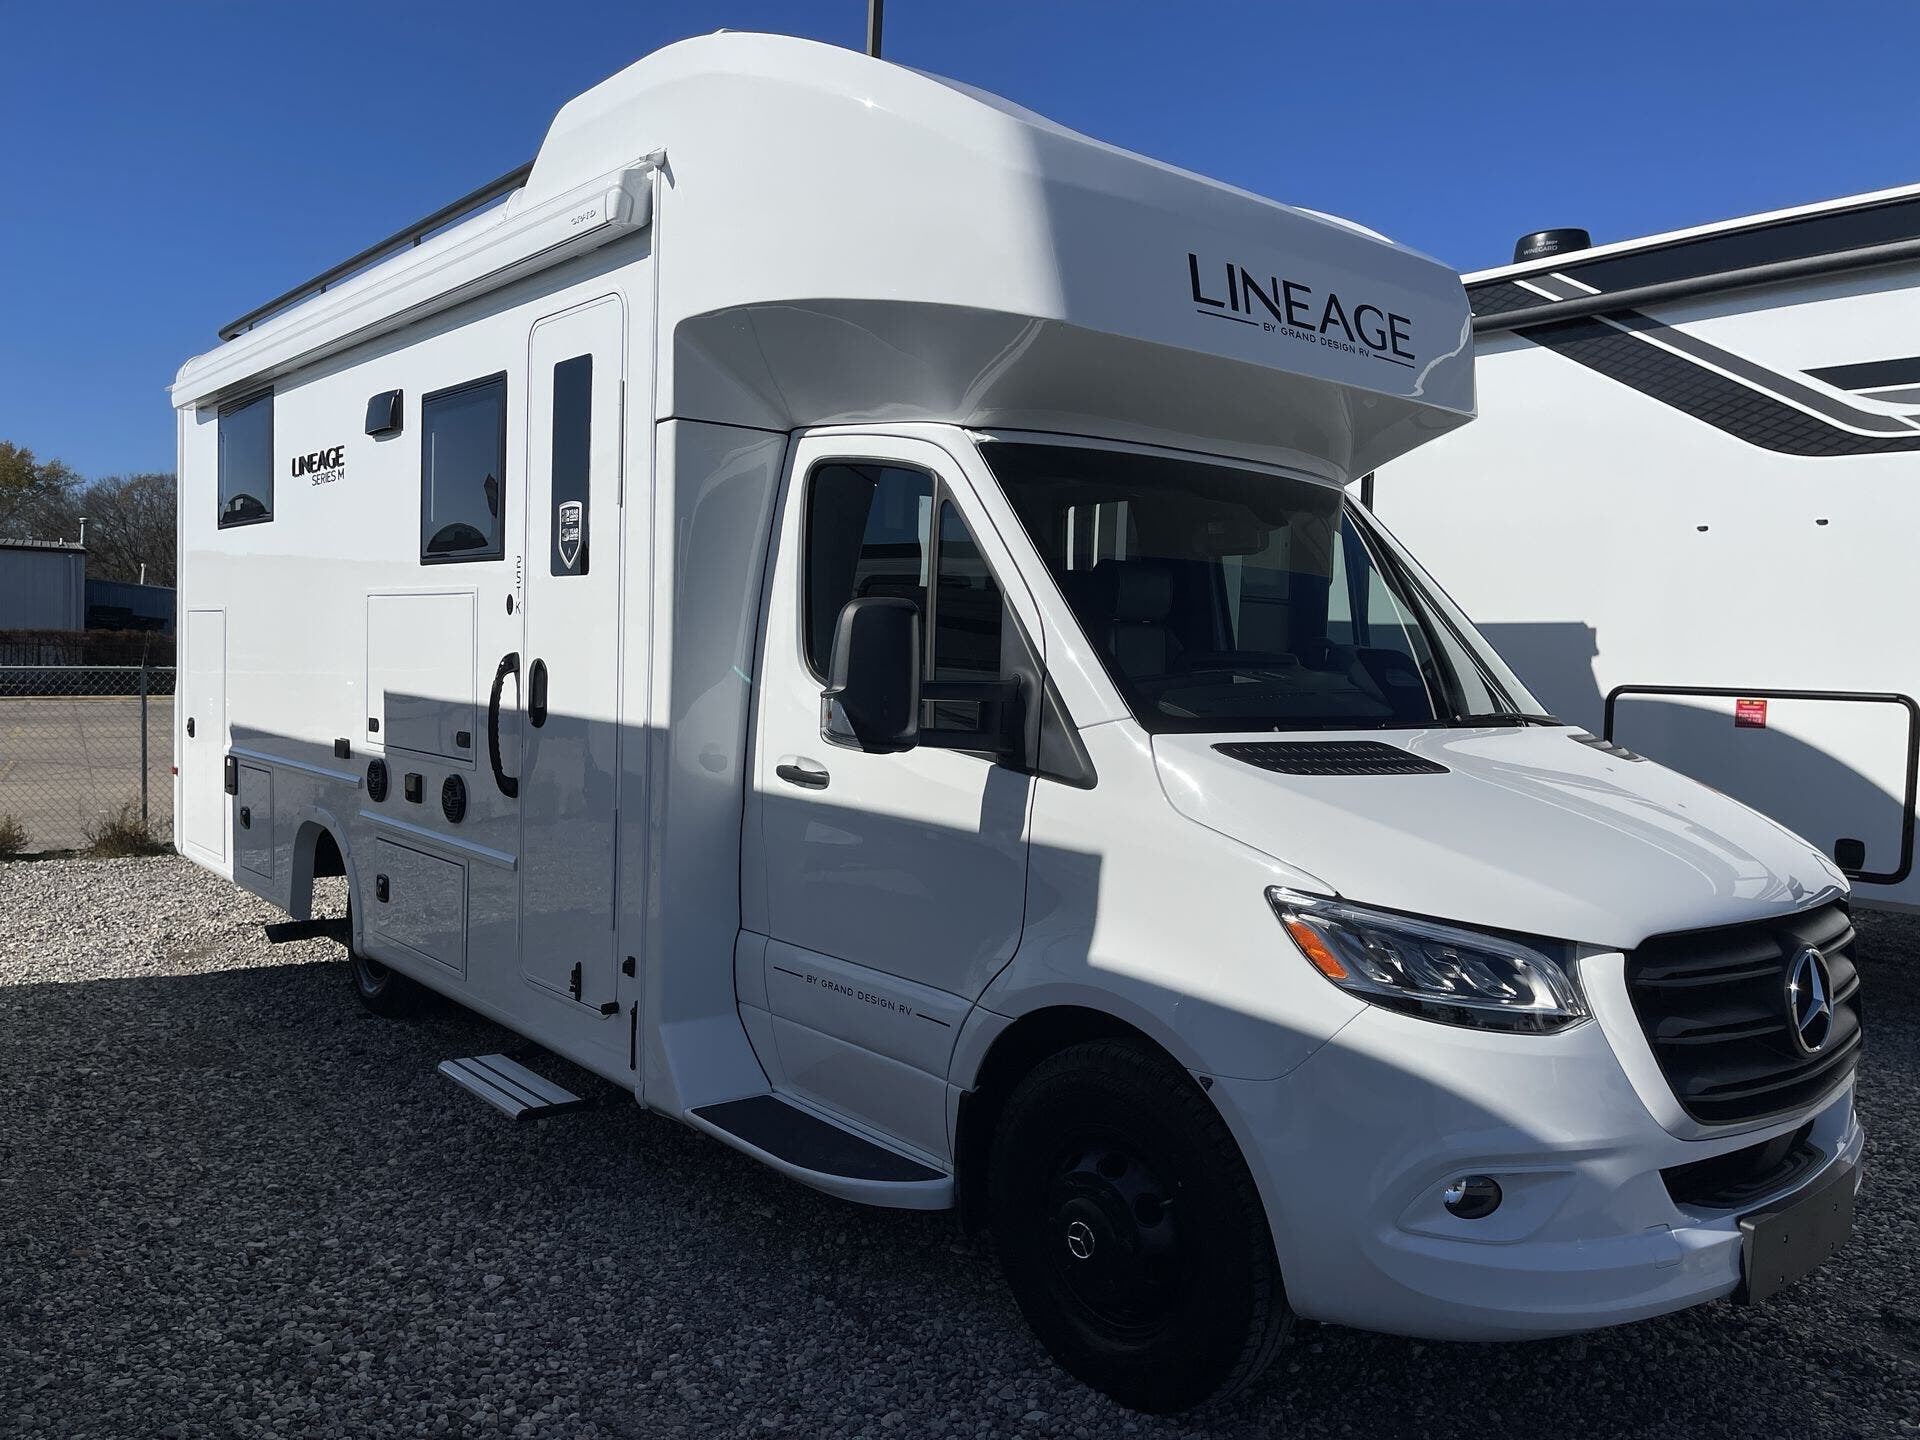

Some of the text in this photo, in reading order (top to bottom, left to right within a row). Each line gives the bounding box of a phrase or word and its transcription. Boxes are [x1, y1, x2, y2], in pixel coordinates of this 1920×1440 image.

[1188, 252, 1416, 361] LINEAGE
[1263, 322, 1370, 358] BY GRAND DESIGN RV
[291, 445, 345, 478] LINEAGE
[311, 468, 345, 486] SERIES M
[806, 974, 913, 1016] BY GRAND DESIGN RV
